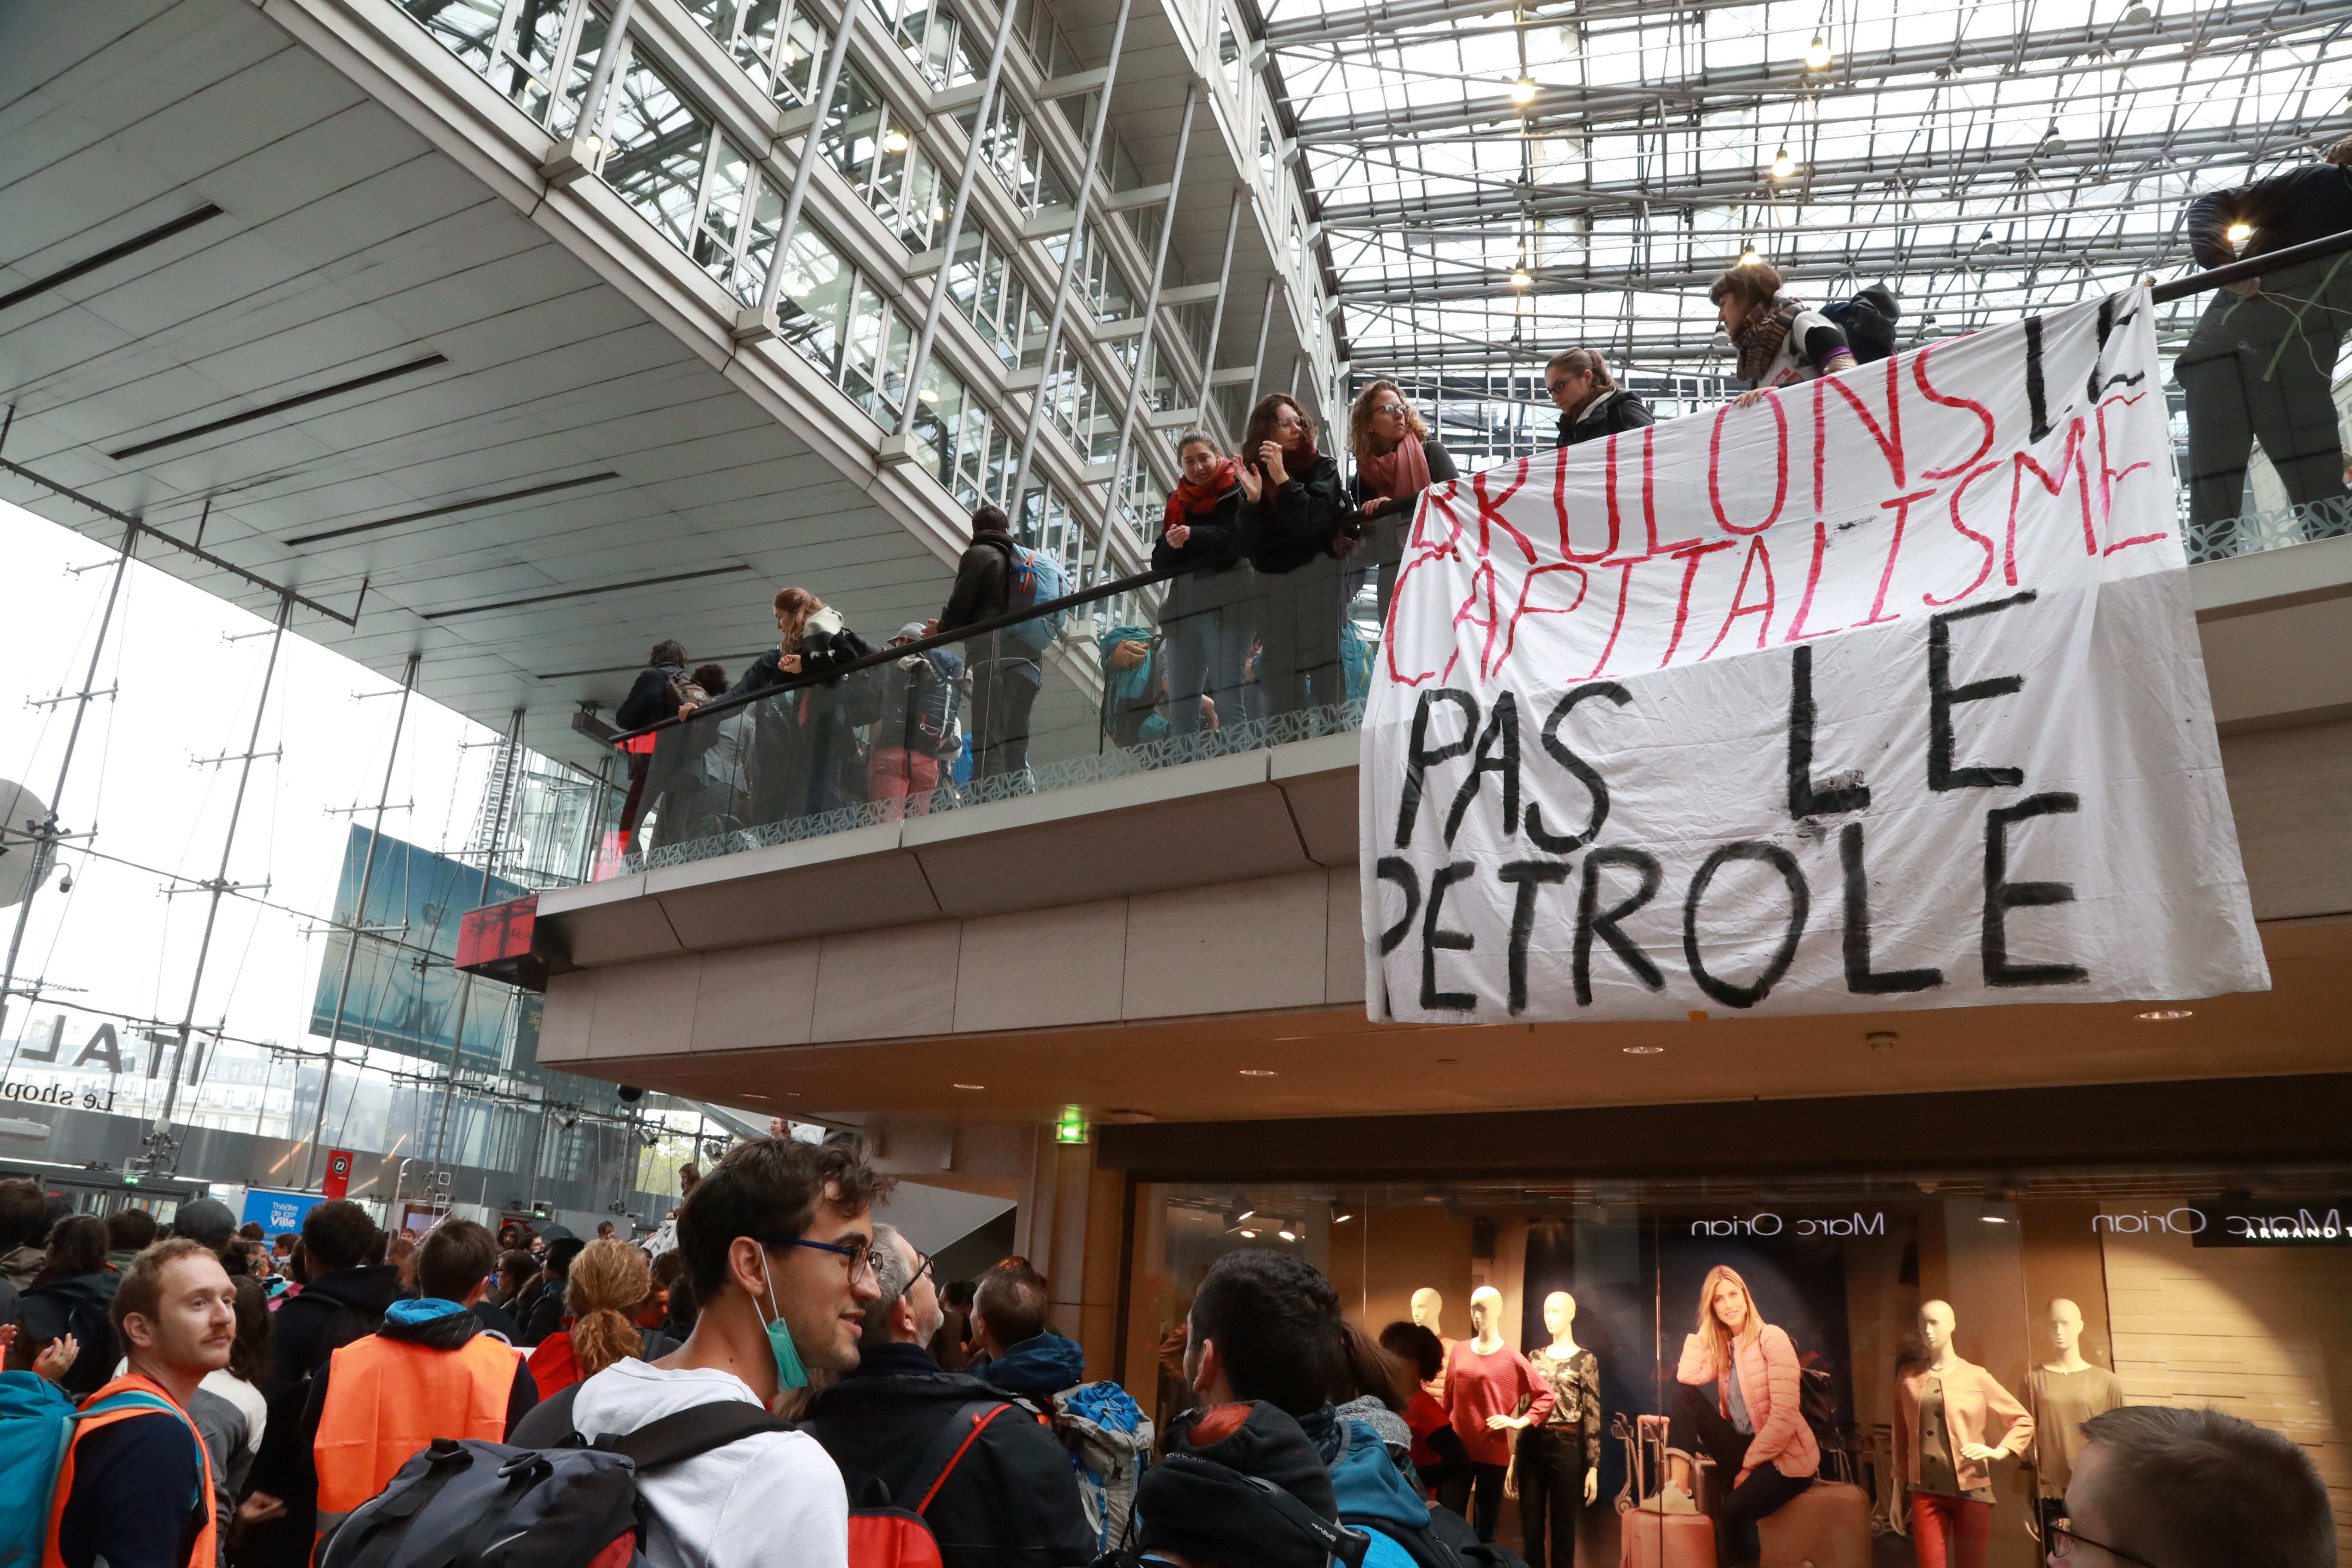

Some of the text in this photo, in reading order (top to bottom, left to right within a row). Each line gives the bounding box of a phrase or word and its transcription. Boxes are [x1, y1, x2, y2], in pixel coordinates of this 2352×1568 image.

[1387, 391, 2168, 687] CAPITALISME
[1411, 292, 2146, 563] BRULONS LE
[1394, 590, 2038, 854] PAS LE
[1376, 791, 2089, 1017] PETROLE
[271, 1216, 295, 1227] Ville
[2246, 1228, 2337, 1238] ARMAND
